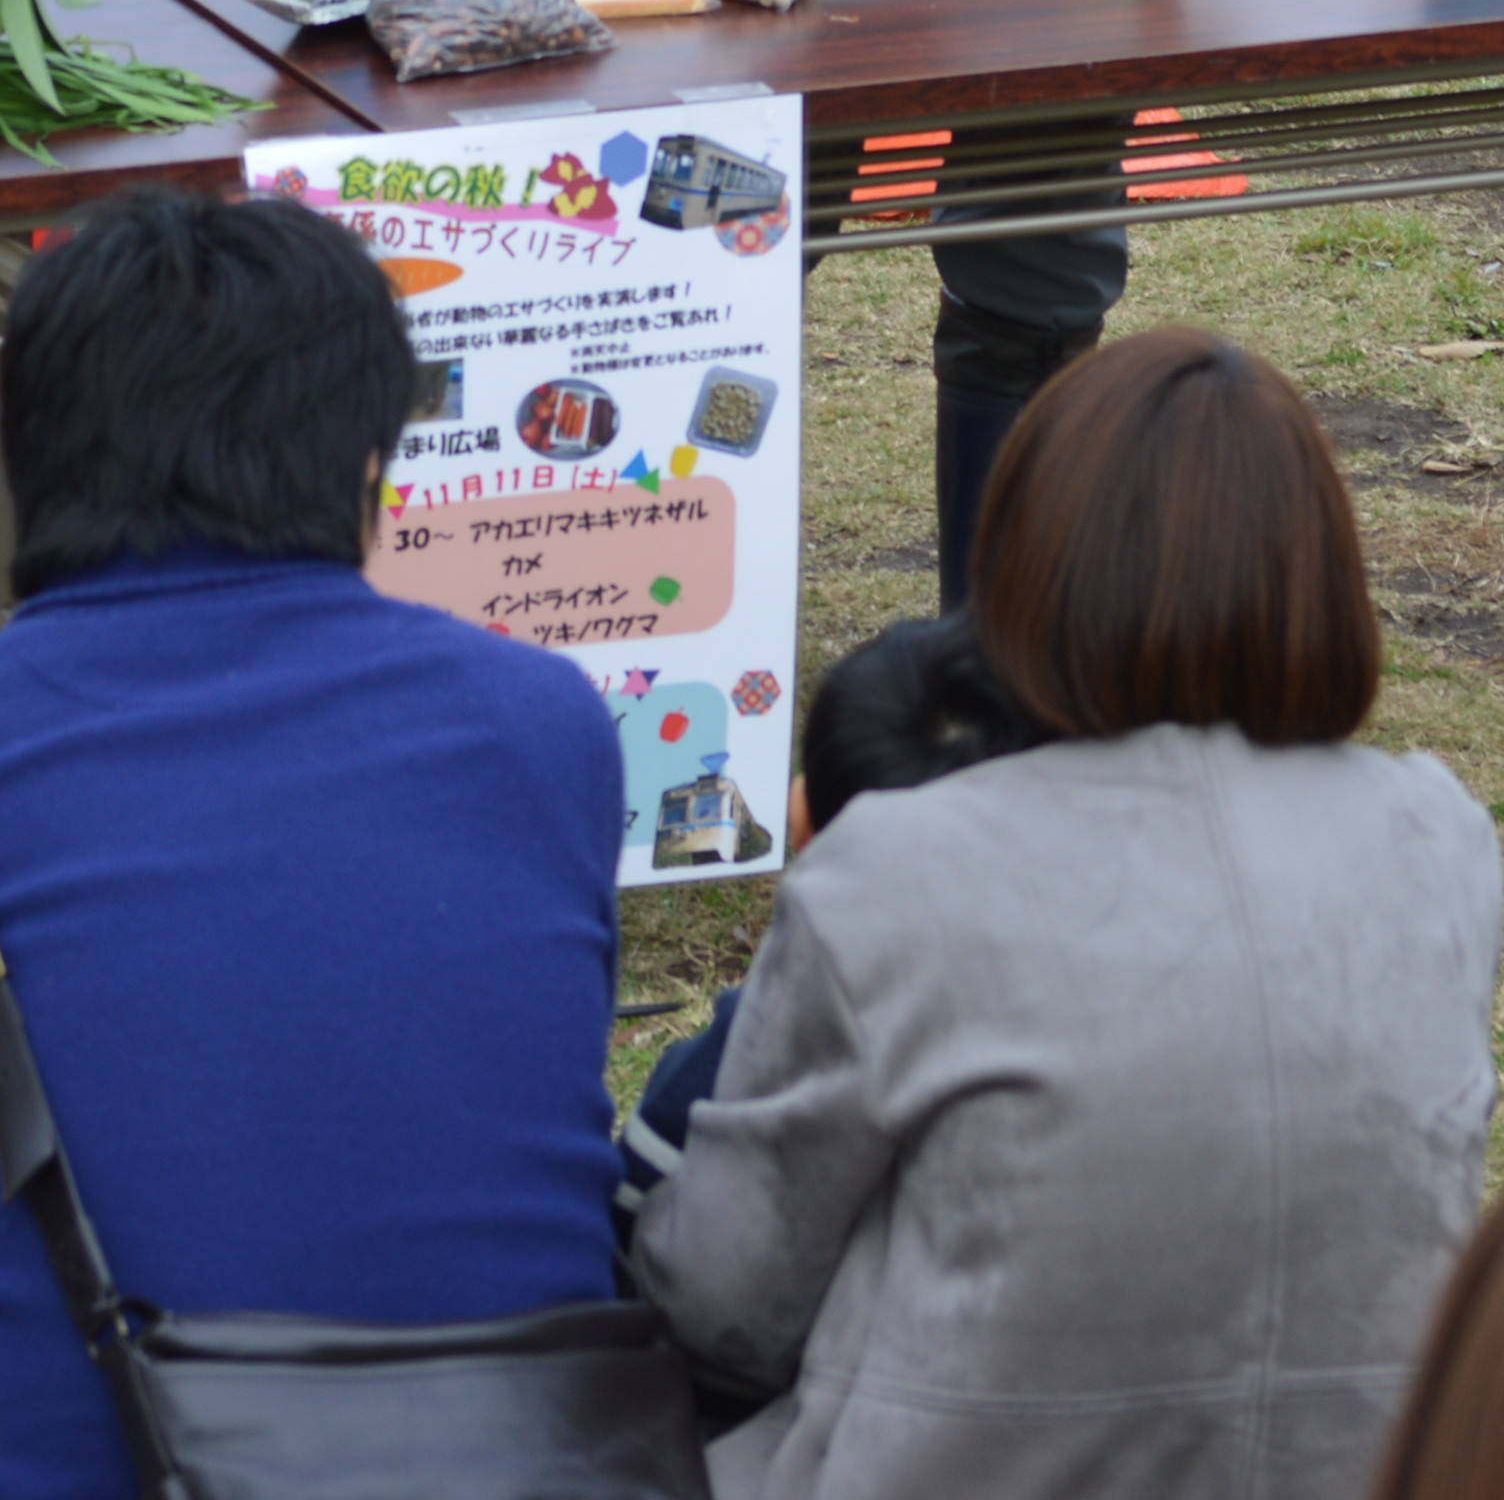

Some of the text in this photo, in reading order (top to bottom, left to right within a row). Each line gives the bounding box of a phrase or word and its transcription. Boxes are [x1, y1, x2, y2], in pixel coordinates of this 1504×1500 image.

[338, 155, 540, 210] 食欲の秋！
[413, 304, 732, 355] の出来ない華麗なる手さばきをご覧あれ！
[394, 425, 501, 459] まり広場
[470, 499, 709, 544] アカエリマキキツネザル
[502, 553, 543, 577] カメ
[482, 582, 629, 617] インドライオン
[533, 613, 659, 645] ツキノワグマ
